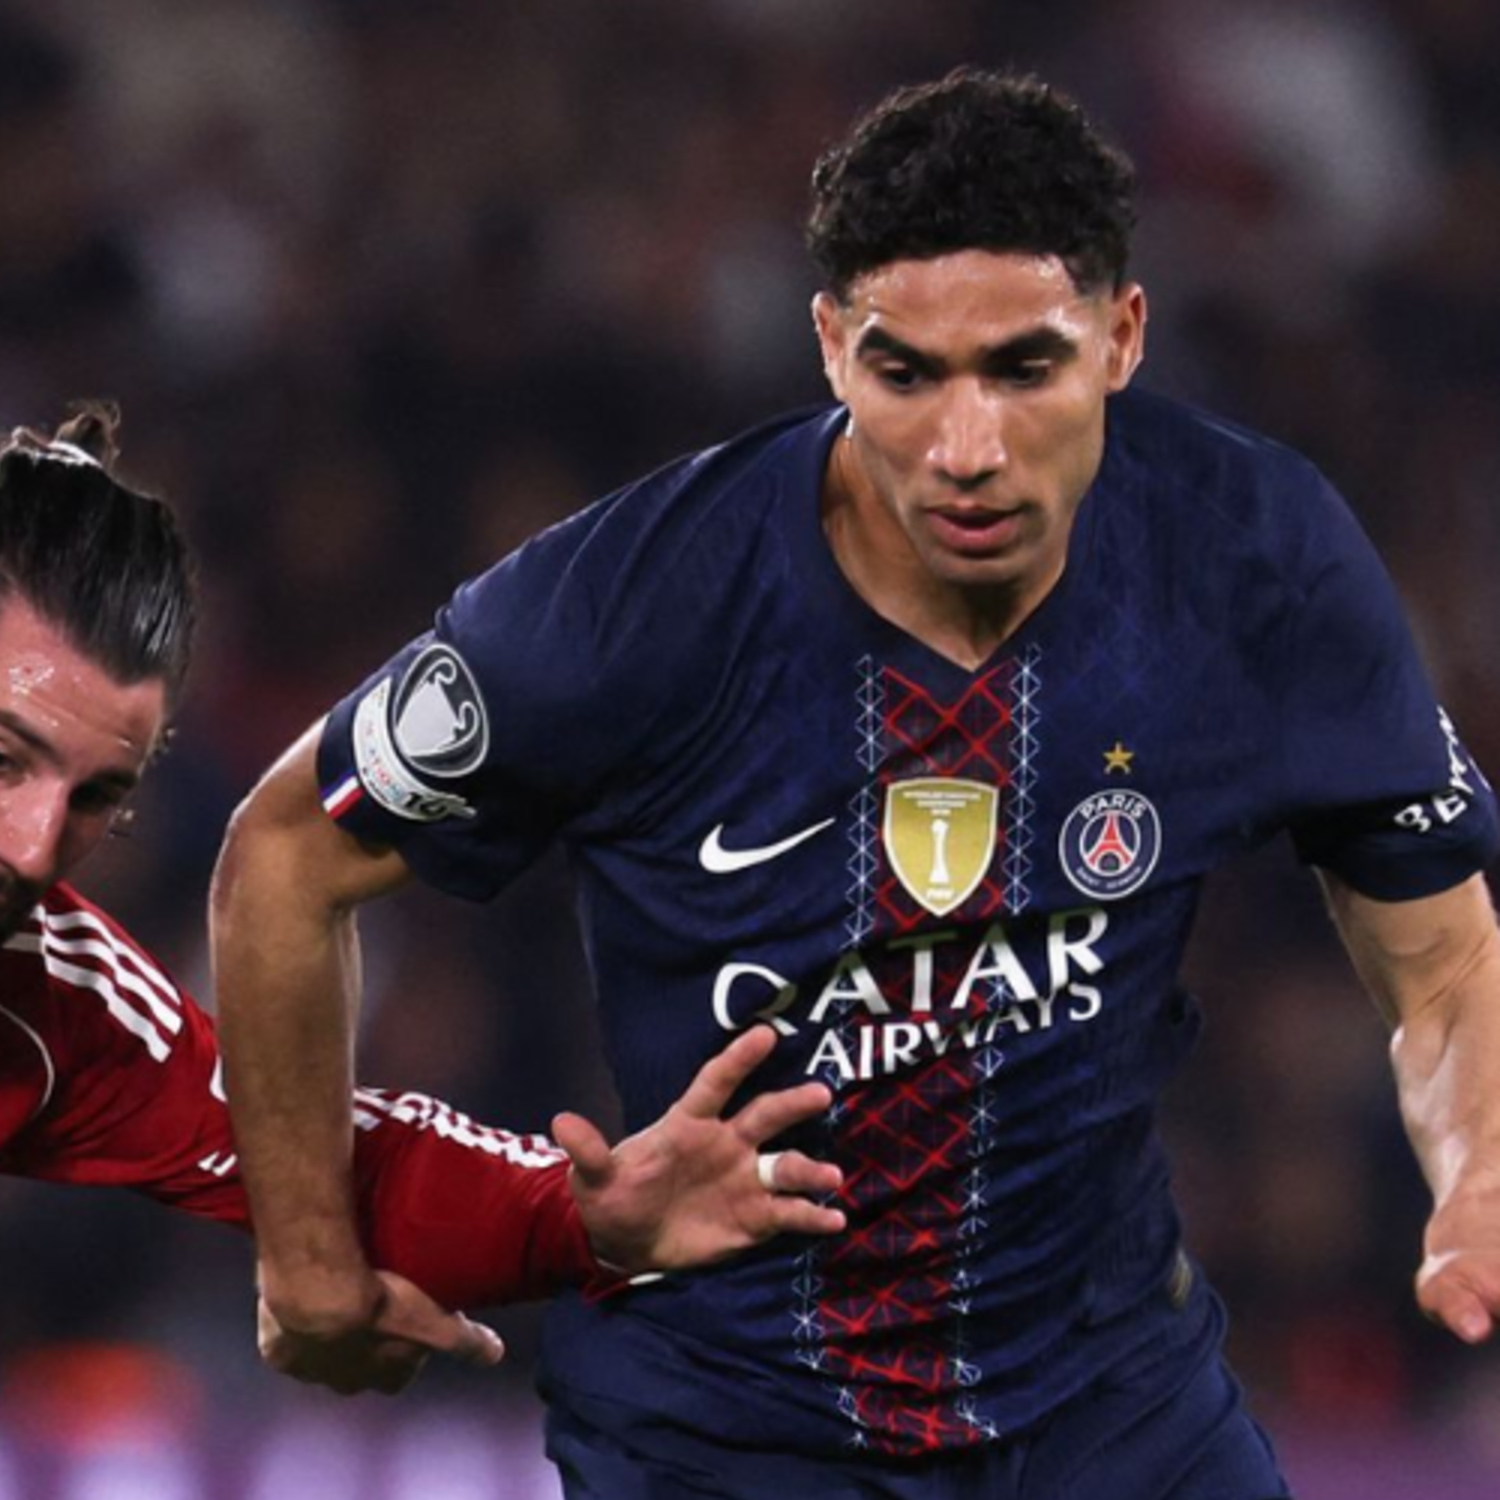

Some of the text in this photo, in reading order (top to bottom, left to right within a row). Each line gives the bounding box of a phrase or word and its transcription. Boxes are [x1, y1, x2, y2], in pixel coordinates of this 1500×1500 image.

[1079, 793, 1148, 820] PARIS
[712, 907, 1108, 1036] QATAR
[805, 981, 1102, 1081] AIRWAYS
